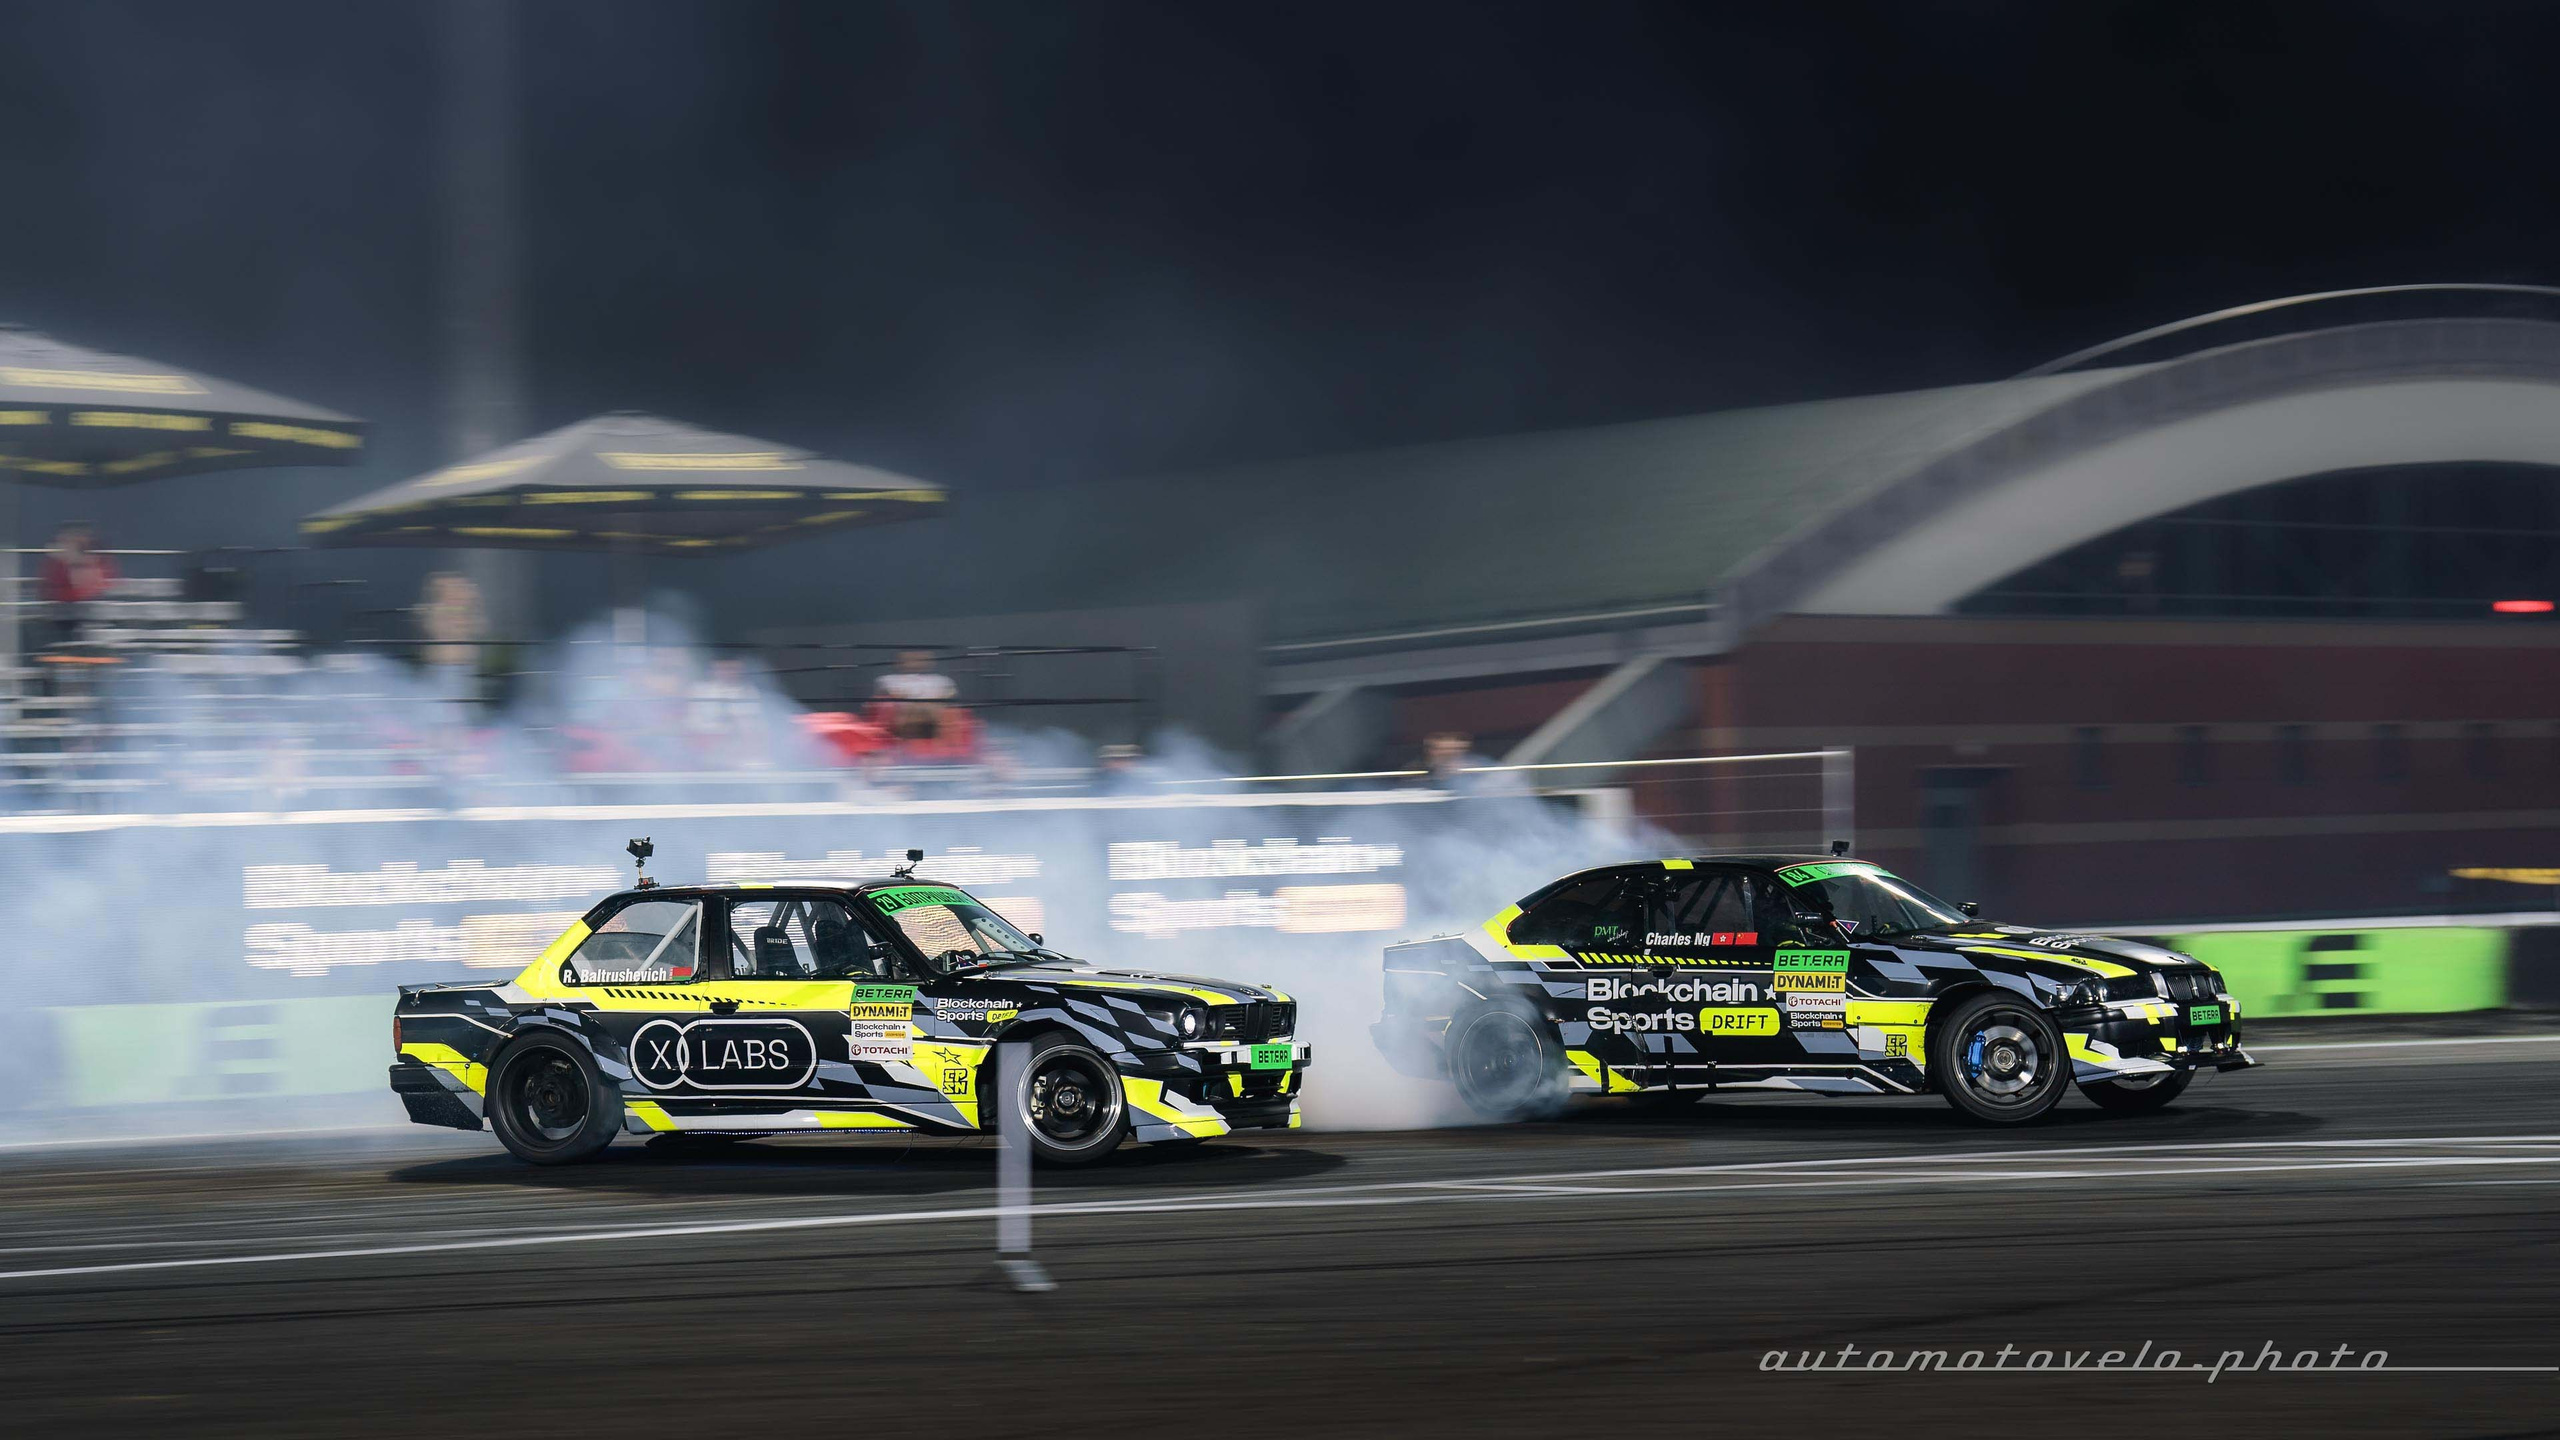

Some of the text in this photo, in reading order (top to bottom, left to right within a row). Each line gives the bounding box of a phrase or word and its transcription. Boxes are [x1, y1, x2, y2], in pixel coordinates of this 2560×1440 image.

[1786, 869, 1809, 881] 84
[876, 896, 898, 910] 29
[1594, 926, 1618, 937] DMT
[1646, 932, 1691, 946] Charles
[563, 968, 667, 983] R. Baltrushevich
[936, 998, 1014, 1009] Blockchain
[1799, 998, 1841, 1006] TOTACHI
[936, 1010, 985, 1023] Sports
[1587, 1007, 1769, 1034] Sports DRIFT
[1790, 1012, 1838, 1020] Blockchain
[855, 1023, 901, 1031] Blockchain
[1791, 1019, 1821, 1028] Sports
[855, 1031, 884, 1039] Sports
[649, 1039, 790, 1070] X LABS
[863, 1046, 908, 1055] TOTACHI
